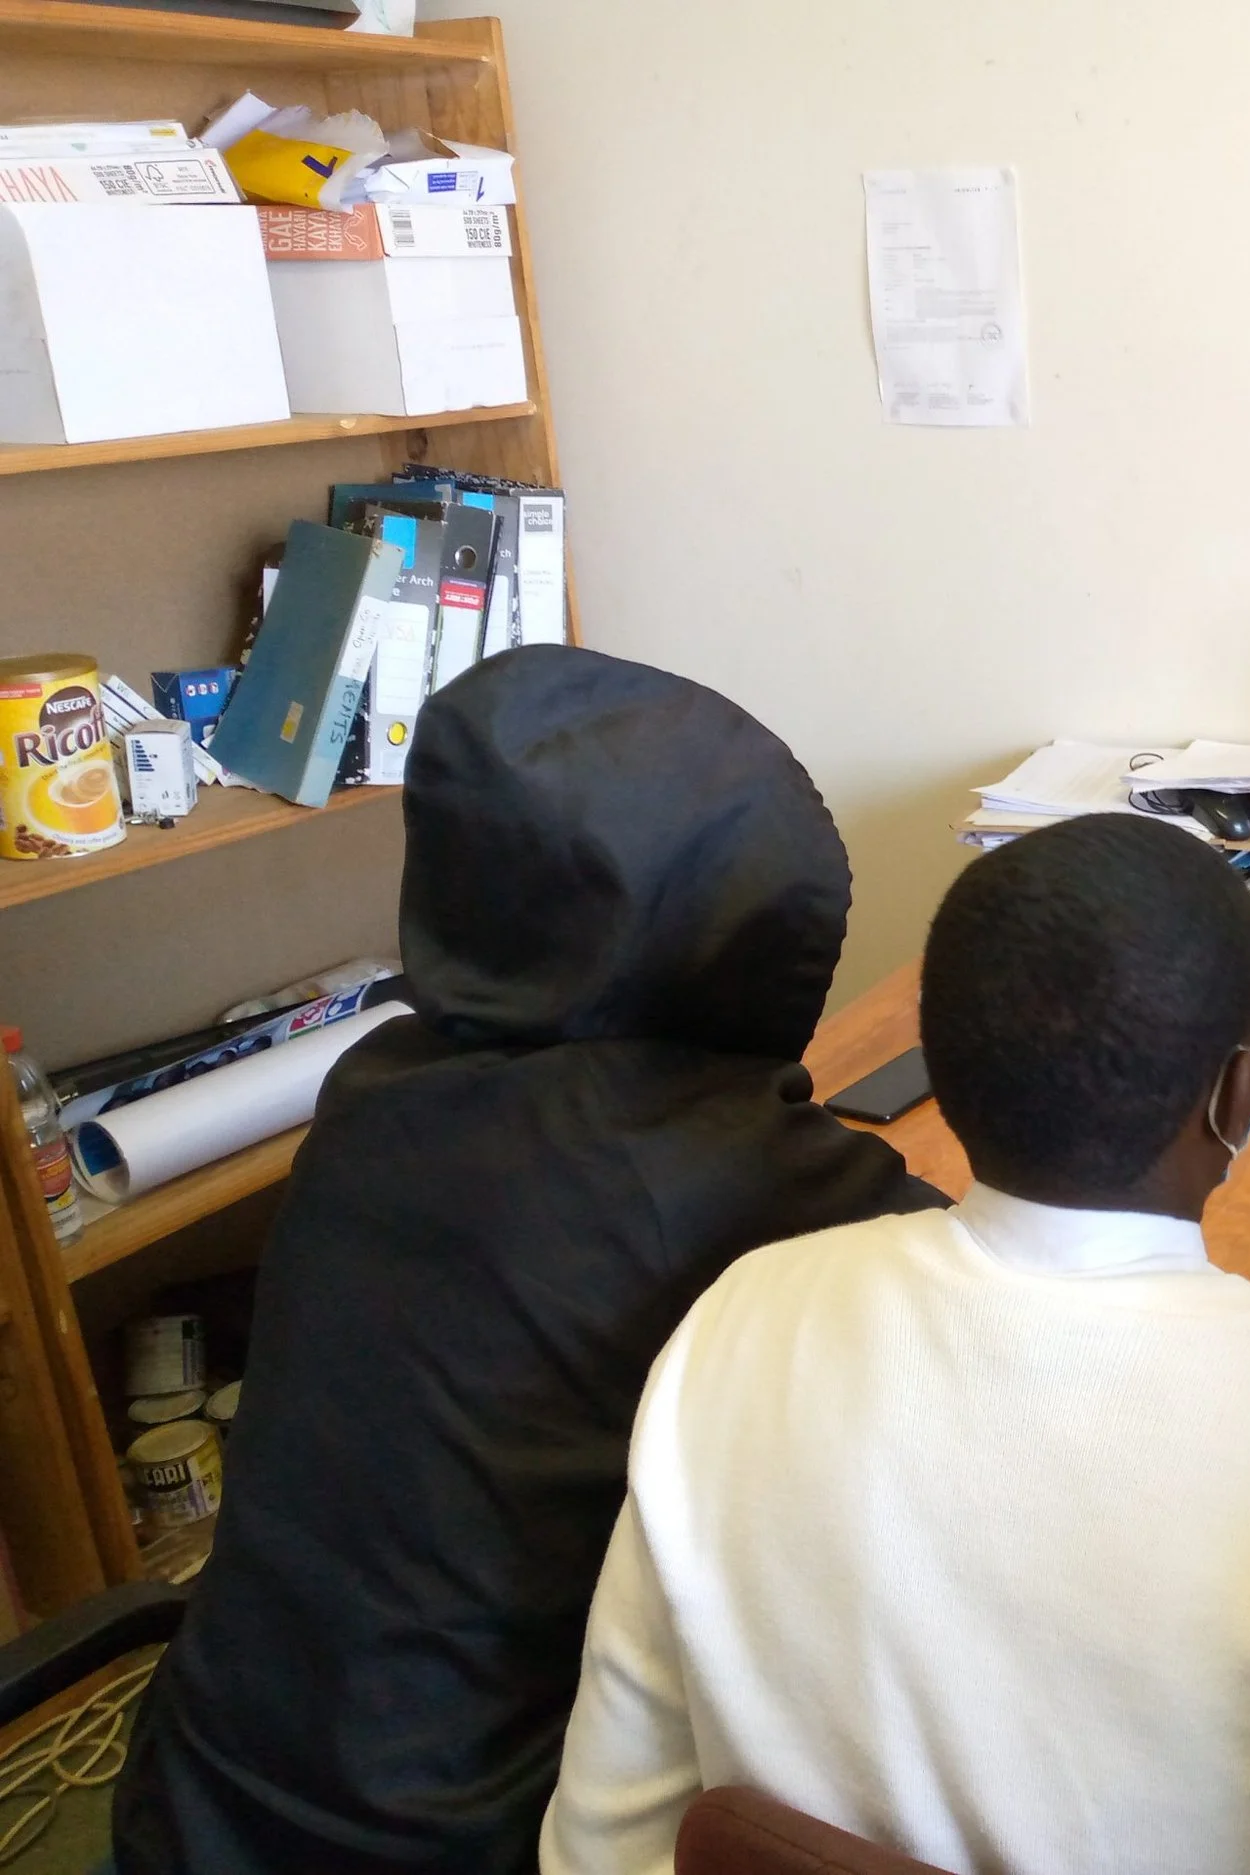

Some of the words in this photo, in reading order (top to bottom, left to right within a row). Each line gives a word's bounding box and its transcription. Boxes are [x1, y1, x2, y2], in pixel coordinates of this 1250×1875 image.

[0, 165, 80, 203] HAYA
[269, 210, 293, 252] GAE
[307, 211, 328, 252] KAYA
[409, 575, 434, 587] Arch
